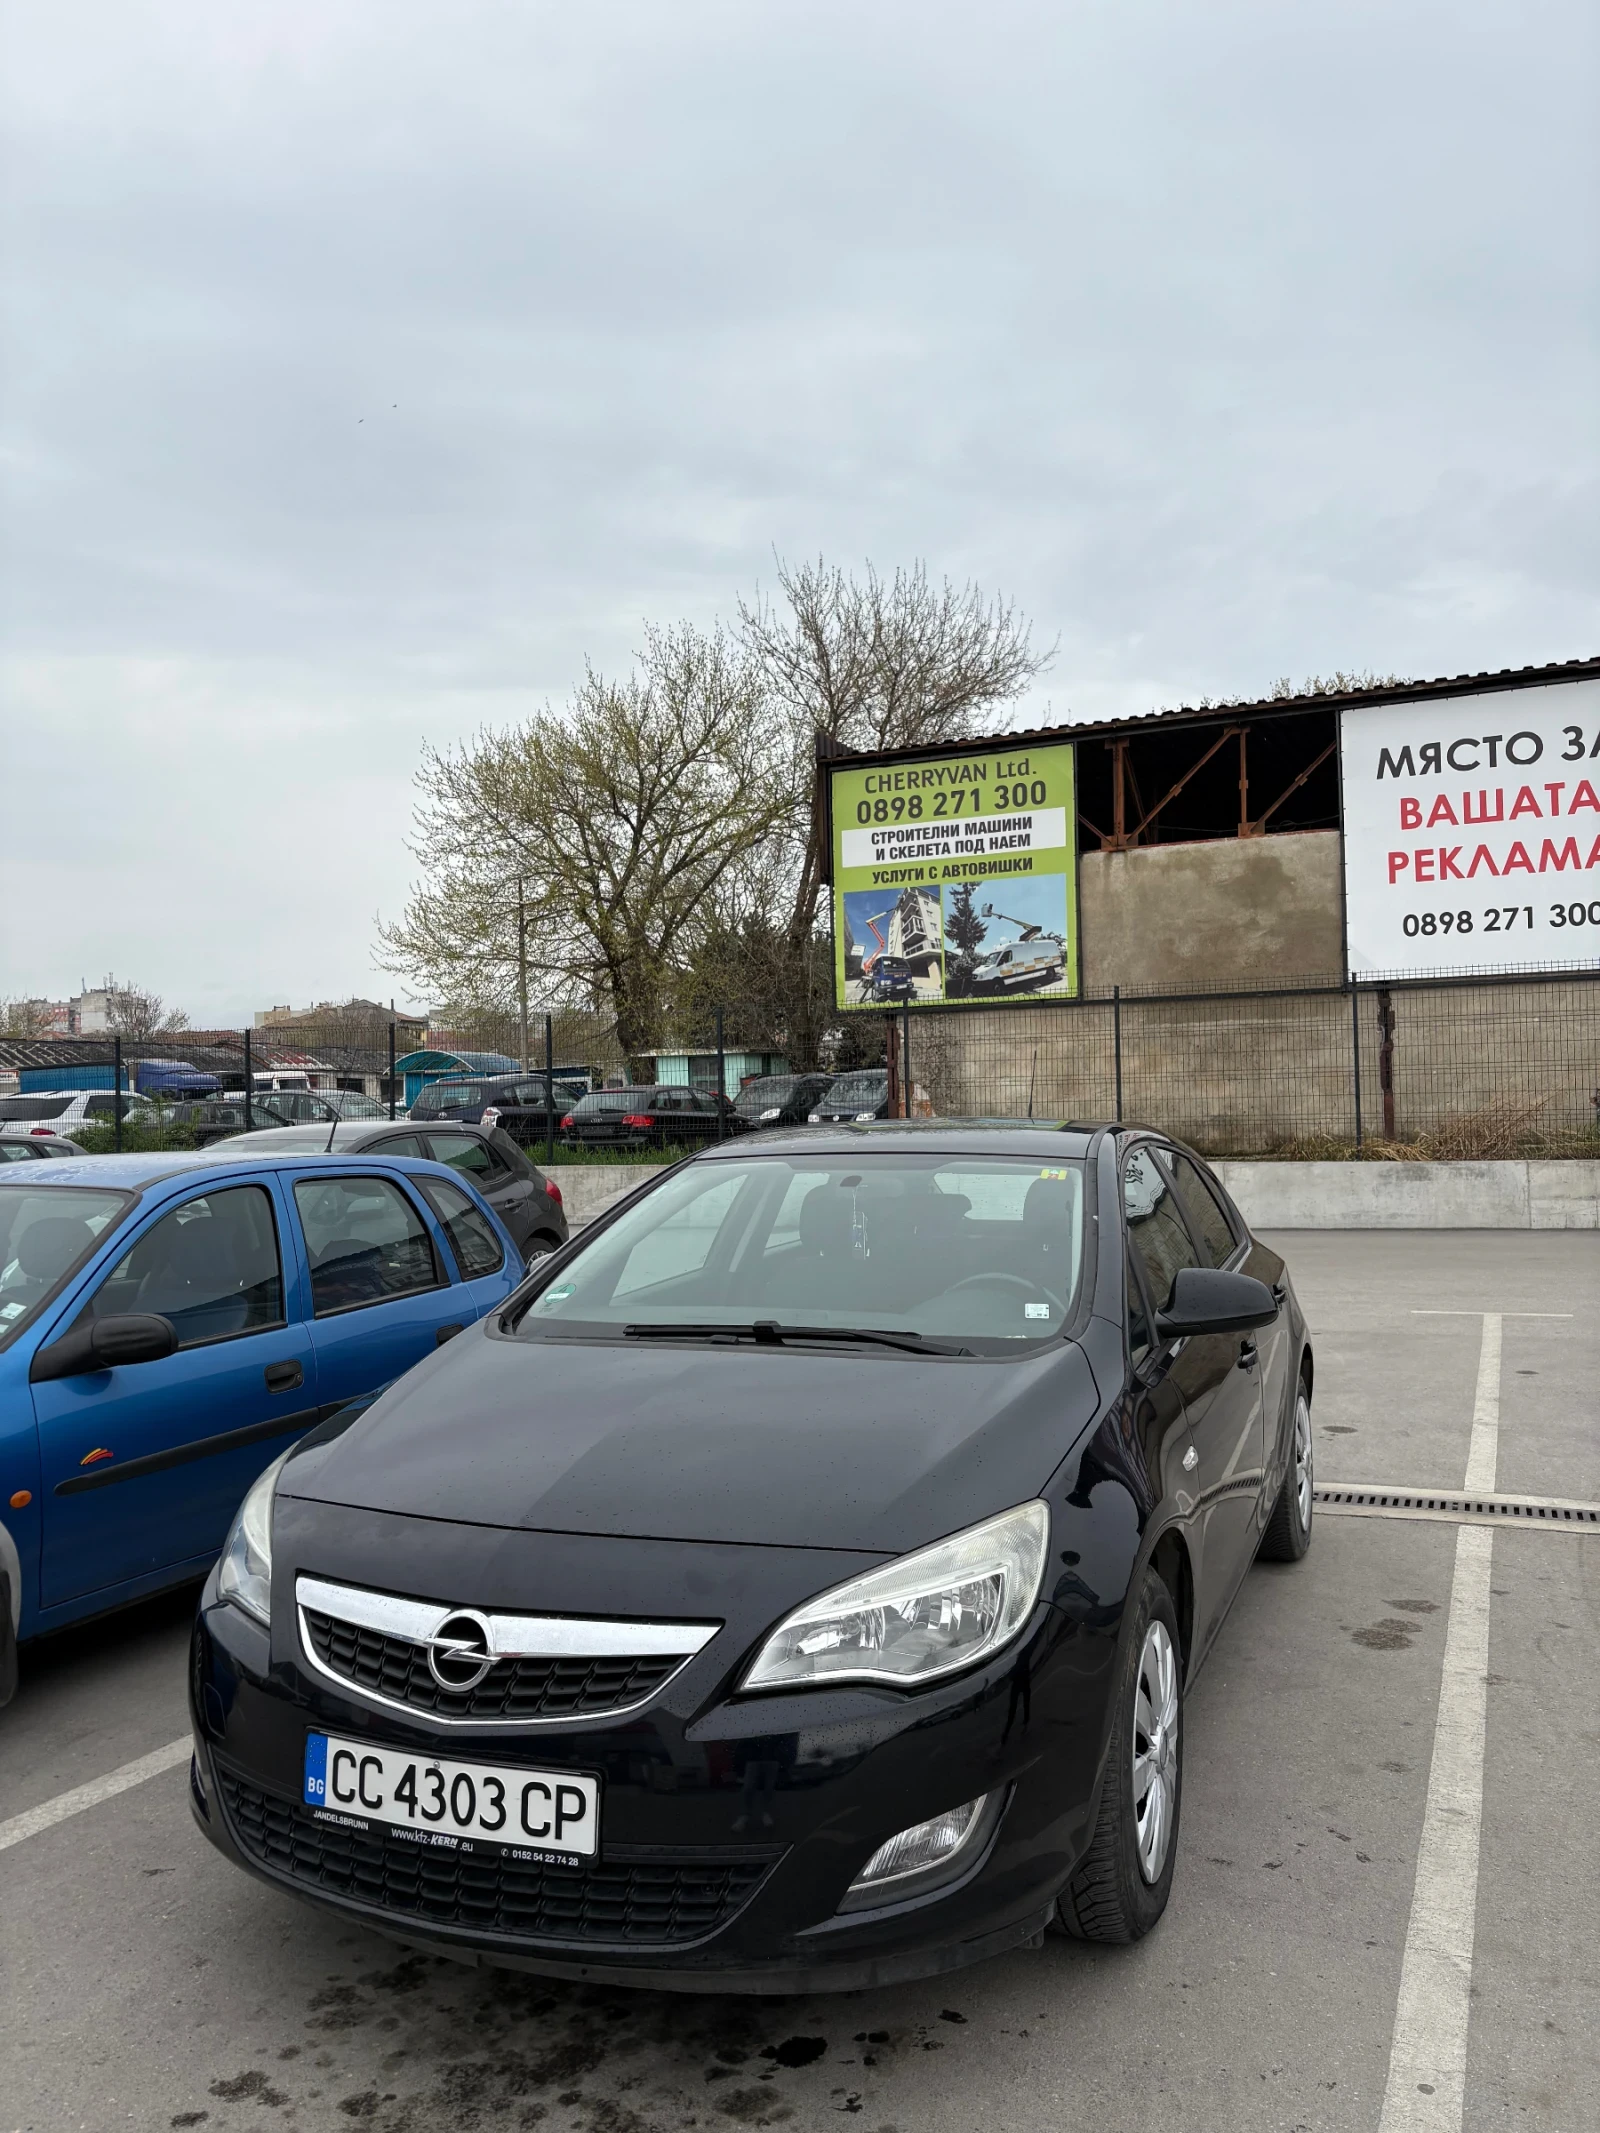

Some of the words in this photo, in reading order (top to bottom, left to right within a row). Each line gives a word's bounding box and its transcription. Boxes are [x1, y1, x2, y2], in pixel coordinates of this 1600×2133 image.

[1376, 731, 1544, 780] МЯСТО
[865, 763, 987, 794] CHERRYVAN
[996, 758, 1037, 779] Ltd.
[857, 795, 923, 824] 0898
[933, 788, 980, 816] 271
[994, 780, 1046, 809] 300
[1400, 780, 1600, 830] ВАШАТА
[871, 824, 960, 845] СТРОИТЕЛНИ
[965, 817, 1032, 835] МАШИНИ
[876, 849, 885, 861] И
[889, 841, 951, 859] СКЕЛЕТА
[955, 840, 985, 855] ПОД
[990, 834, 1031, 850] НАЕМ
[872, 866, 924, 884] УСЛУГИ
[929, 866, 937, 879] С
[942, 858, 1033, 878] АВТОВИШКИ
[1402, 910, 1474, 937] 0898
[1484, 906, 1534, 931] 271
[1549, 901, 1600, 928] 300
[308, 1777, 324, 1795] BG
[332, 1749, 383, 1809] CC
[394, 1763, 507, 1831] 4303
[520, 1781, 586, 1840] CP
[313, 1810, 368, 1830] JANDELSBRUNN
[512, 1851, 531, 1860] 0152
[533, 1853, 542, 1861] 54
[545, 1855, 554, 1863] 22
[557, 1856, 566, 1864] 74
[568, 1858, 578, 1866] 28
